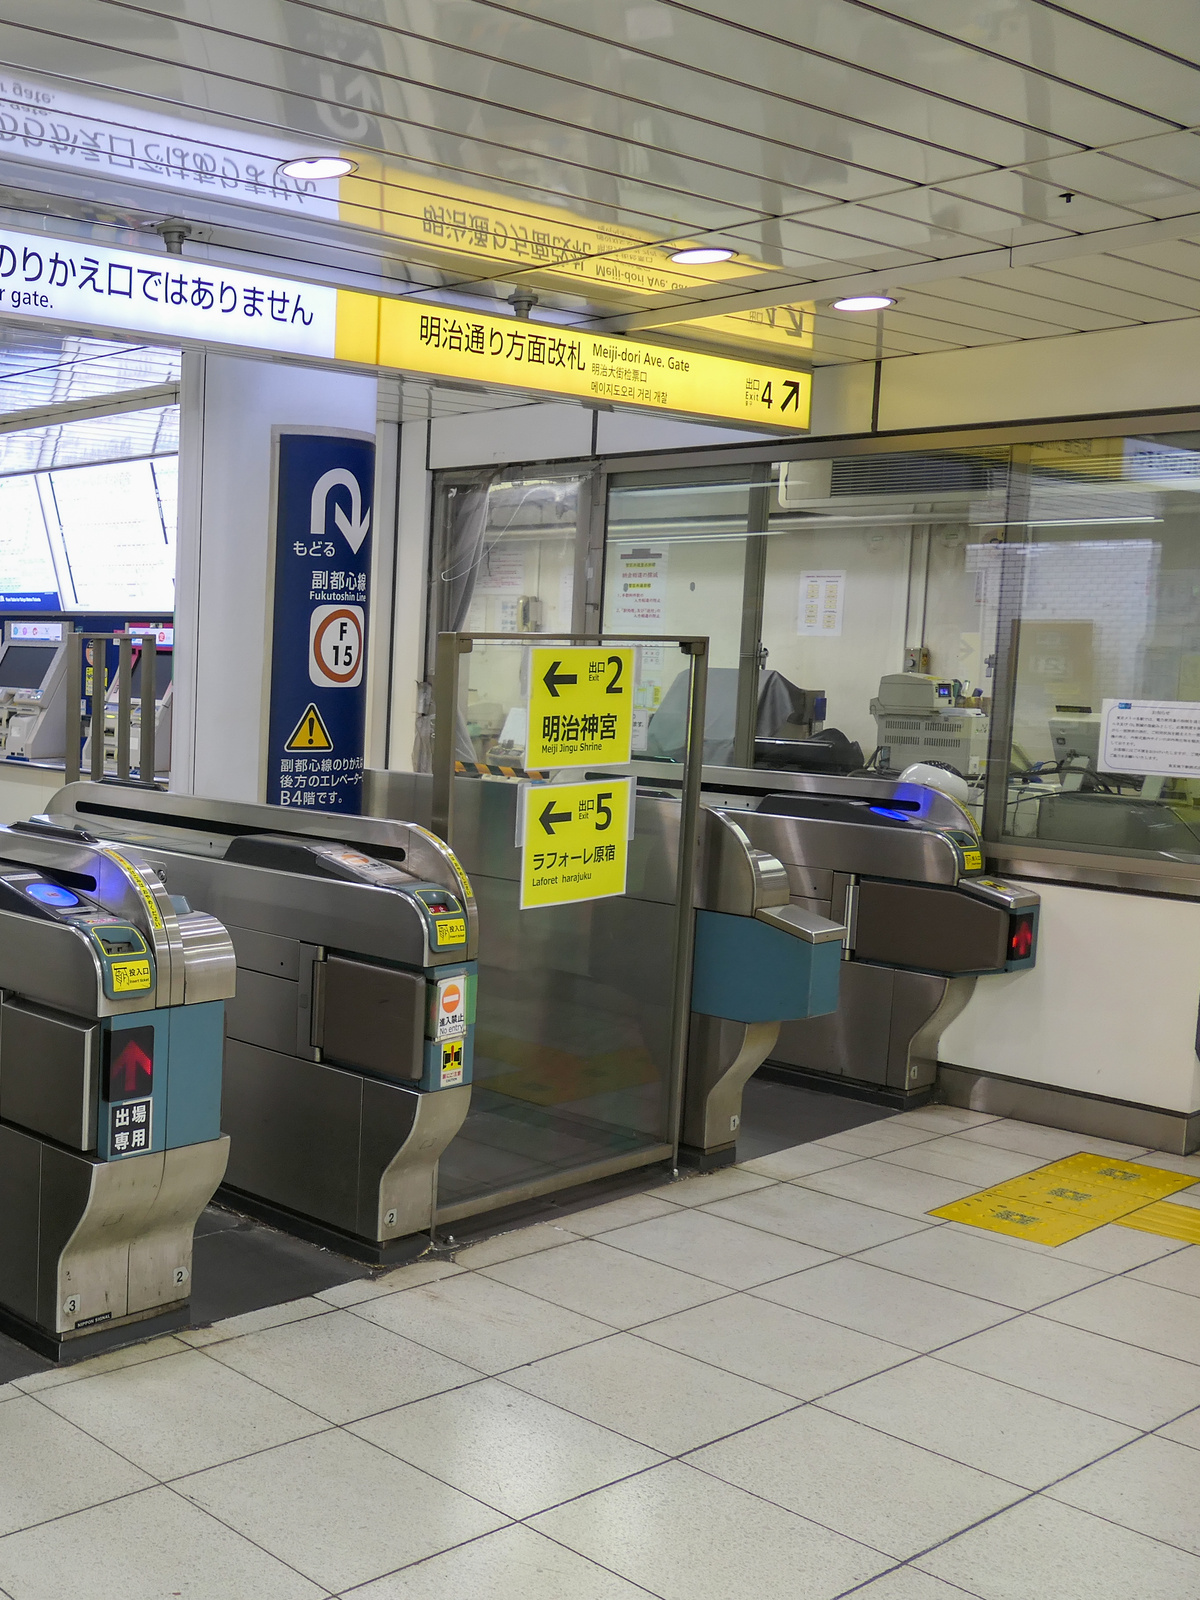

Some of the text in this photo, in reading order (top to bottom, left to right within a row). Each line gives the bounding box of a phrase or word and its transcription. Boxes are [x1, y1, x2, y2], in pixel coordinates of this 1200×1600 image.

[10, 289, 54, 311] gate.
[419, 314, 587, 371] 明治通り方面改札
[592, 343, 690, 372] Meiji-dori Ave. Gate
[745, 378, 760, 391] 出口
[745, 391, 759, 401] Exit
[761, 381, 773, 409] 4
[293, 541, 336, 557] もどる
[311, 570, 367, 591] 副都心線
[309, 590, 367, 602] Fukutoshin Line
[339, 622, 348, 642] F
[332, 645, 353, 667] 15
[588, 661, 605, 674] 出口
[605, 656, 623, 694] 2
[588, 674, 599, 682] Exit
[542, 714, 617, 742] 明治神宮
[541, 742, 602, 755] Meiji Jingu Shrine
[280, 790, 342, 806] B4階です。
[578, 800, 594, 812] 出口
[595, 793, 613, 831] 5
[578, 812, 589, 820] Exit
[533, 844, 616, 871] ラフォーレ原宿
[532, 872, 592, 887] Laforet harajuku
[129, 968, 149, 977] 投入口
[439, 1014, 464, 1027] 進入禁止
[440, 1024, 464, 1035] No entry
[115, 1105, 147, 1127] 出場
[114, 1129, 146, 1151] 専用
[388, 1213, 394, 1223] 2
[176, 1270, 184, 1283] 2
[69, 1300, 76, 1312] 3
[77, 1314, 111, 1327] NIPPON SIGNAL
